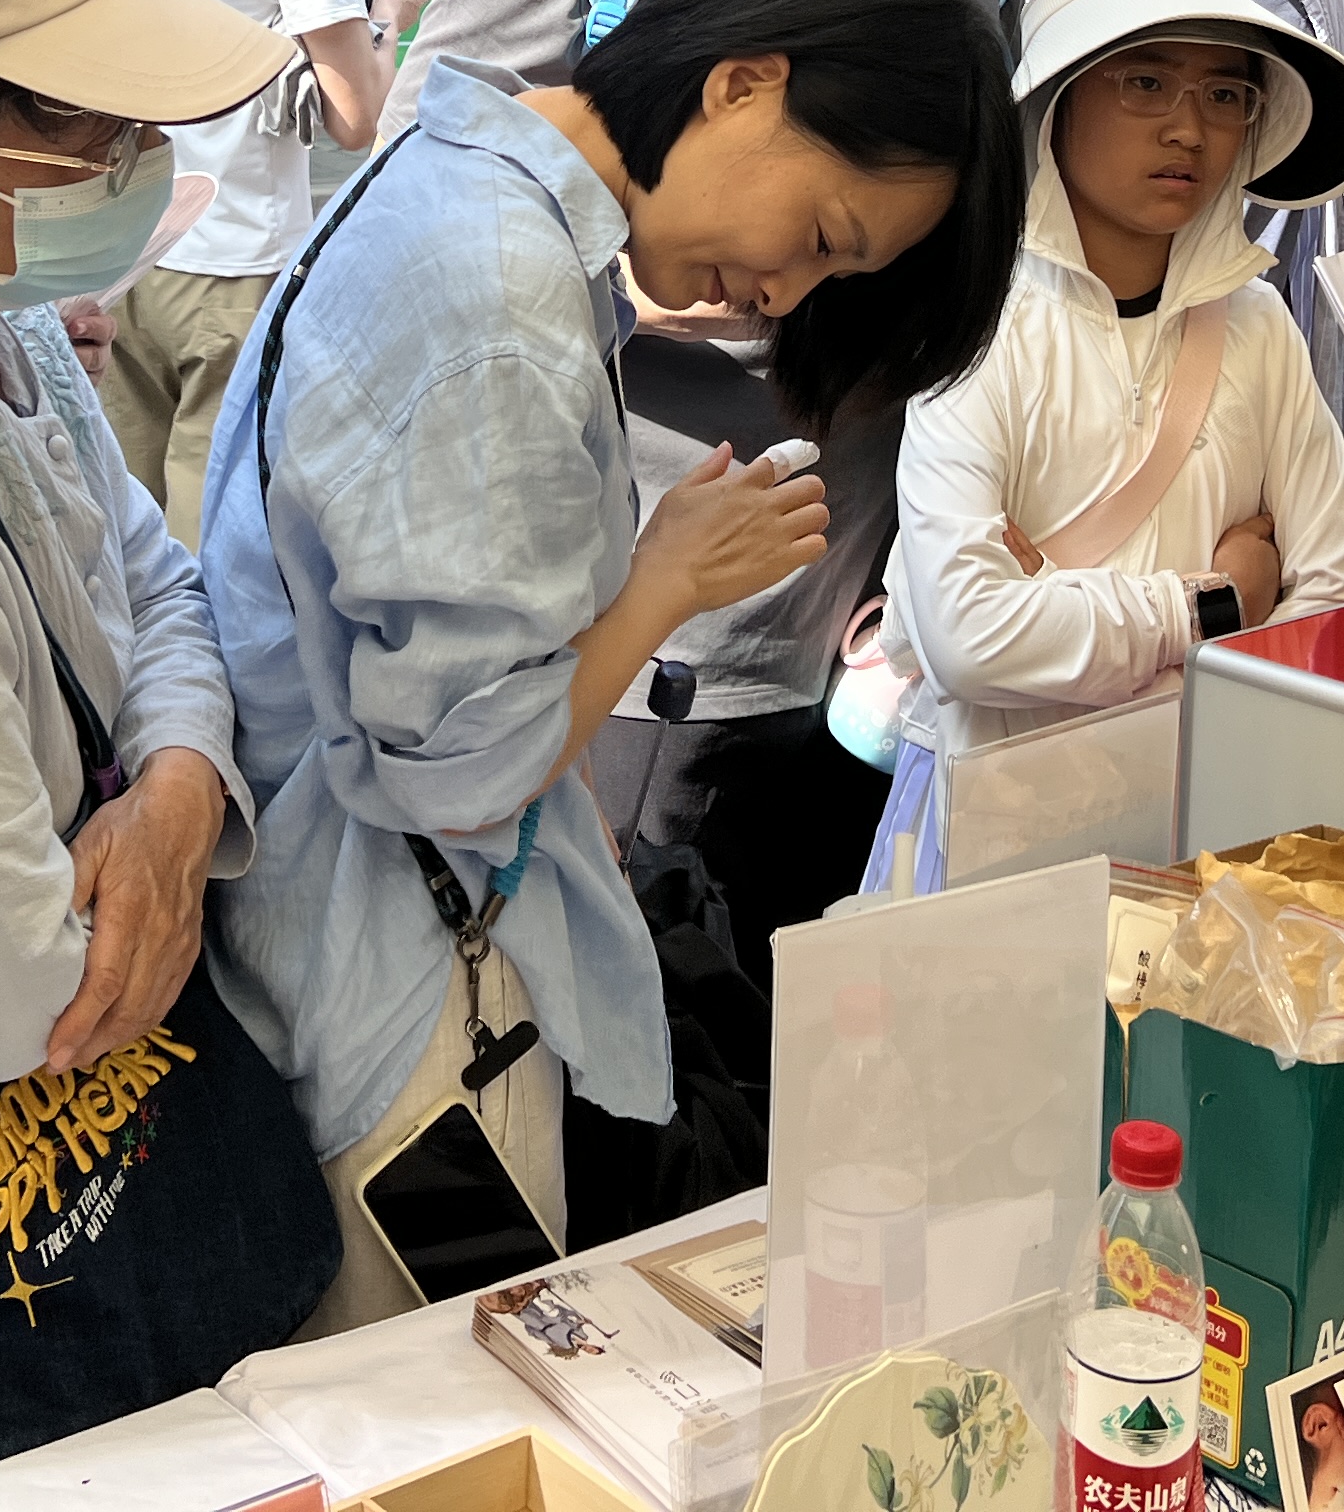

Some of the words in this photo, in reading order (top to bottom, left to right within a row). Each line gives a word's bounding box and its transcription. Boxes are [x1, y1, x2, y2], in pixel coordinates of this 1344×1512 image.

[55, 1024, 197, 1175] HEART
[36, 1221, 71, 1268] TAKE
[76, 1174, 104, 1217] TRIP
[84, 1193, 116, 1243] WITH
[1083, 1474, 1188, 1512] 农夫山泉
